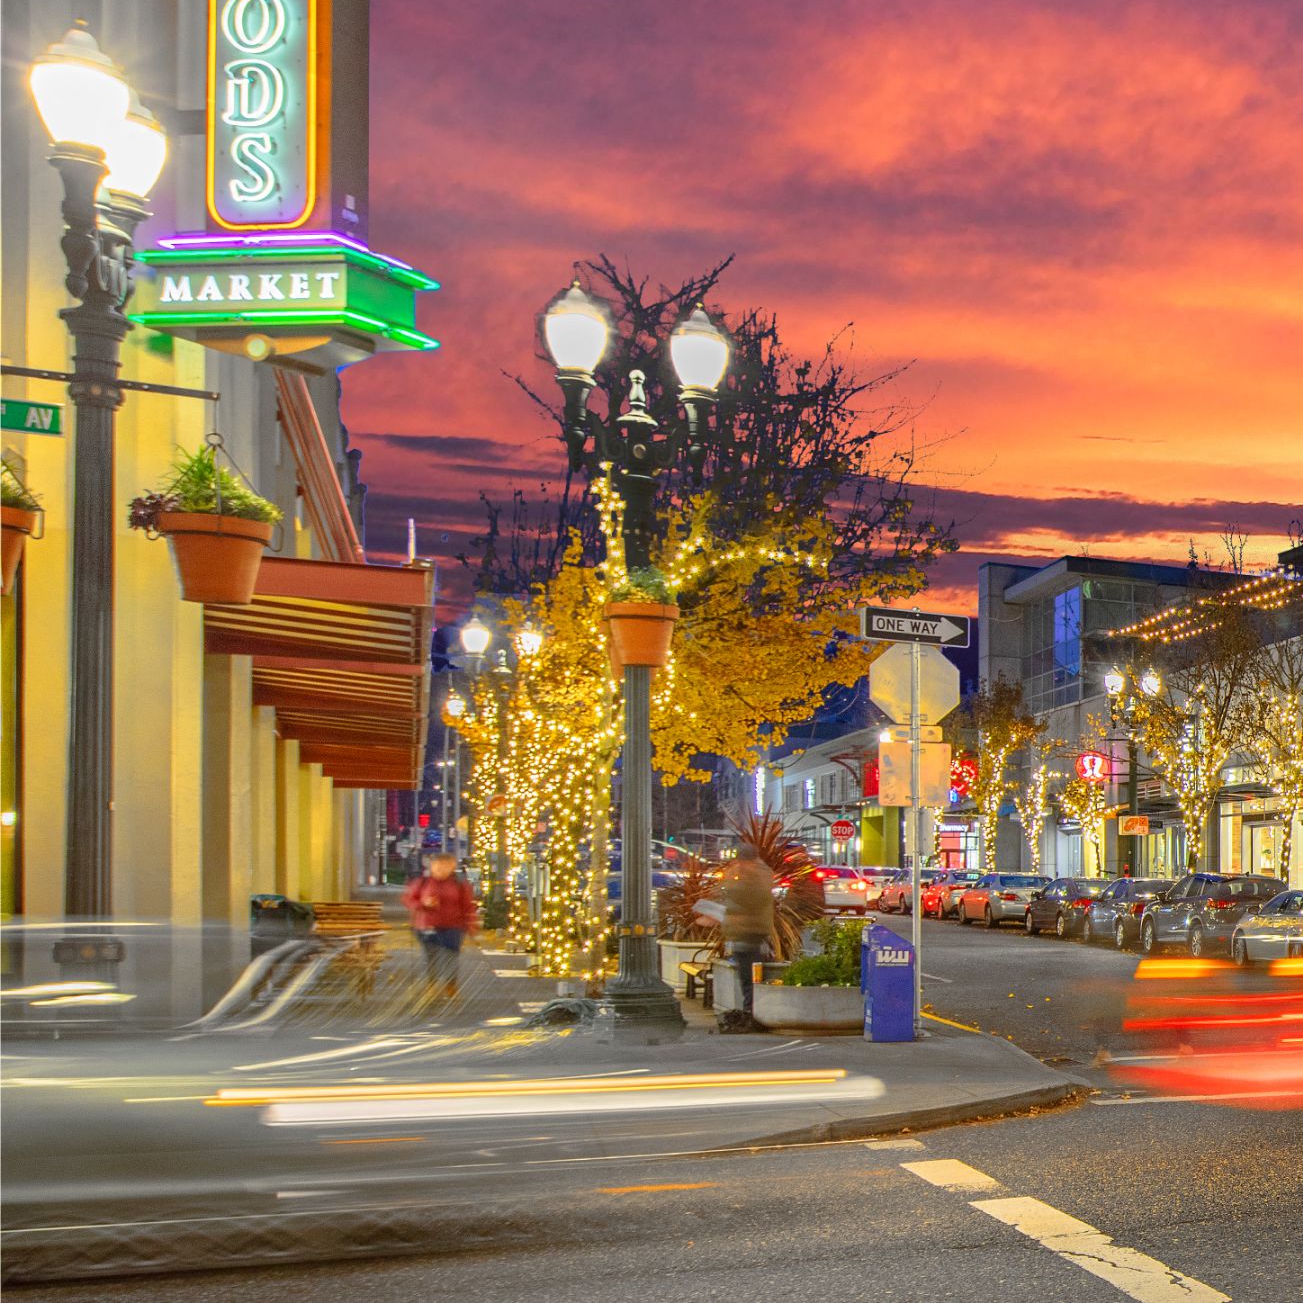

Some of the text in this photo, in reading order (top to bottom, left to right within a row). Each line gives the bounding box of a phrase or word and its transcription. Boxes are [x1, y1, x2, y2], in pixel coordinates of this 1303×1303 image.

[160, 272, 340, 302] MARKET
[25, 406, 54, 430] AV
[876, 617, 938, 635] ONE WAY
[832, 826, 853, 835] STOP
